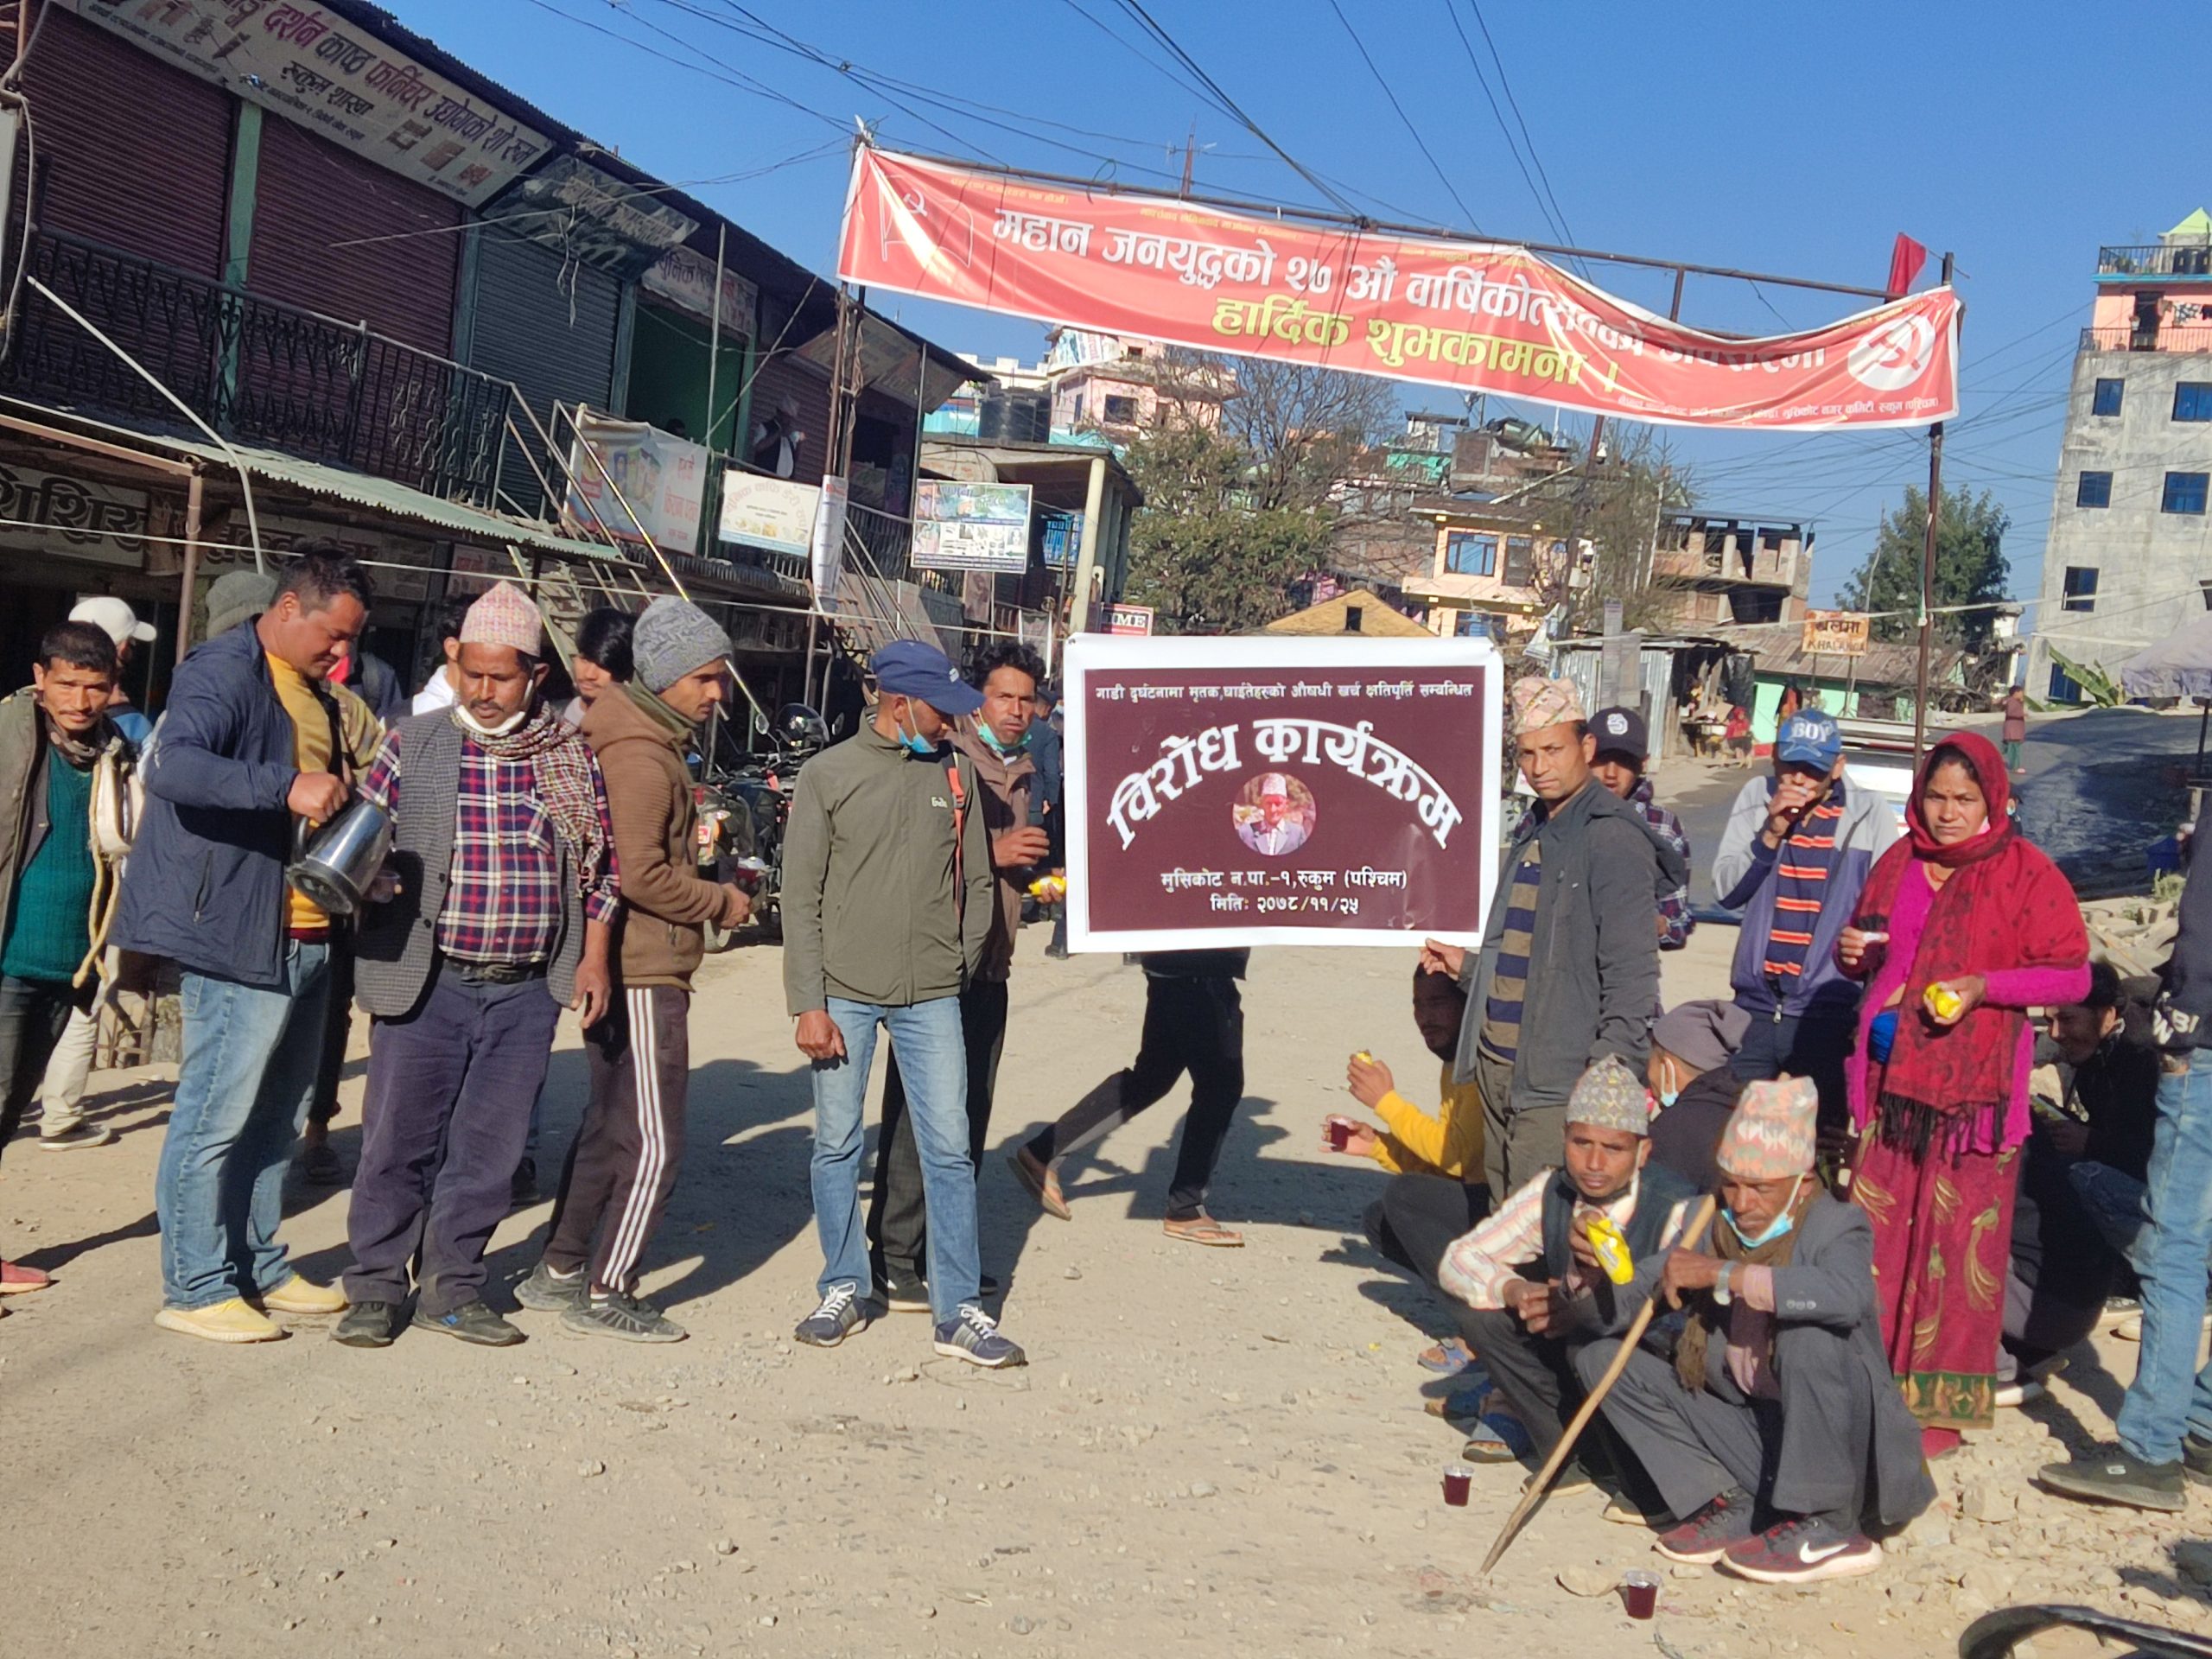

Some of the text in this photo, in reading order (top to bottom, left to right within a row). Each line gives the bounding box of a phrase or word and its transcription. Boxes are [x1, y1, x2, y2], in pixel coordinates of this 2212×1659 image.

[993, 207, 1094, 257] महान
[1102, 226, 1277, 290] जनयुद्धको
[1285, 256, 1332, 294] २७
[1212, 294, 1354, 346] हार्दिक
[1365, 318, 1588, 385] शुभकामना
[1096, 683, 1125, 700] गाडी
[1129, 683, 1185, 703] दुर्घटनामा
[1107, 718, 1464, 851] विरोध कार्यक्रम
[1160, 867, 1224, 893] मुसिकोट
[1344, 866, 1408, 889] (पश्चिम)
[1257, 896, 1359, 914] २०७८/११/२५
